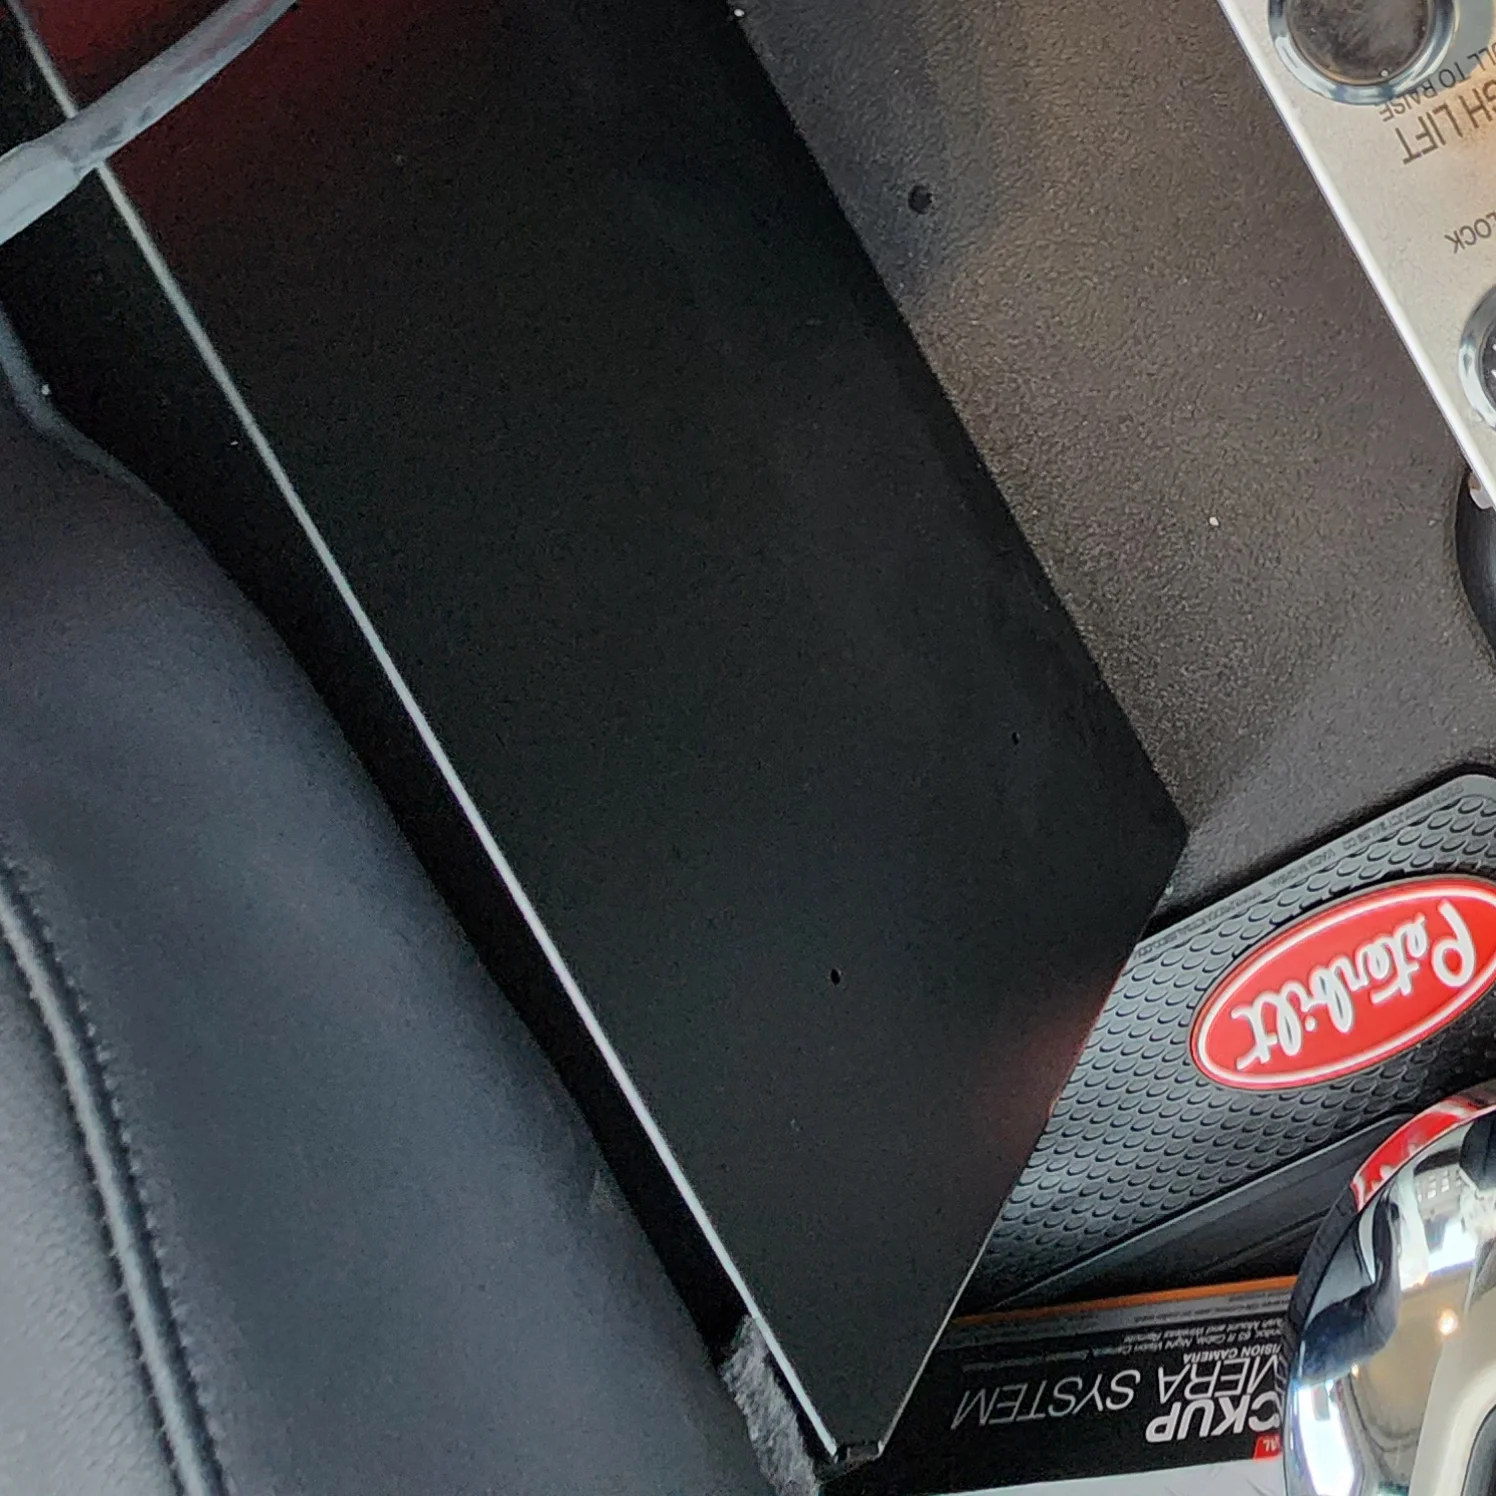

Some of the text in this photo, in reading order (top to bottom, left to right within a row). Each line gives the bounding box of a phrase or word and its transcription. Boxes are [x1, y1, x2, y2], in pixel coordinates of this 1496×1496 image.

[1438, 62, 1471, 89] TO
[1379, 83, 1439, 123] RAISE
[1395, 103, 1464, 165] LIFT
[1231, 899, 1476, 1070] Peterbilt
[1183, 1348, 1239, 1364] CAMERA
[951, 1353, 1284, 1430] MERA SYSTEM
[1145, 1391, 1282, 1442] CKUP
